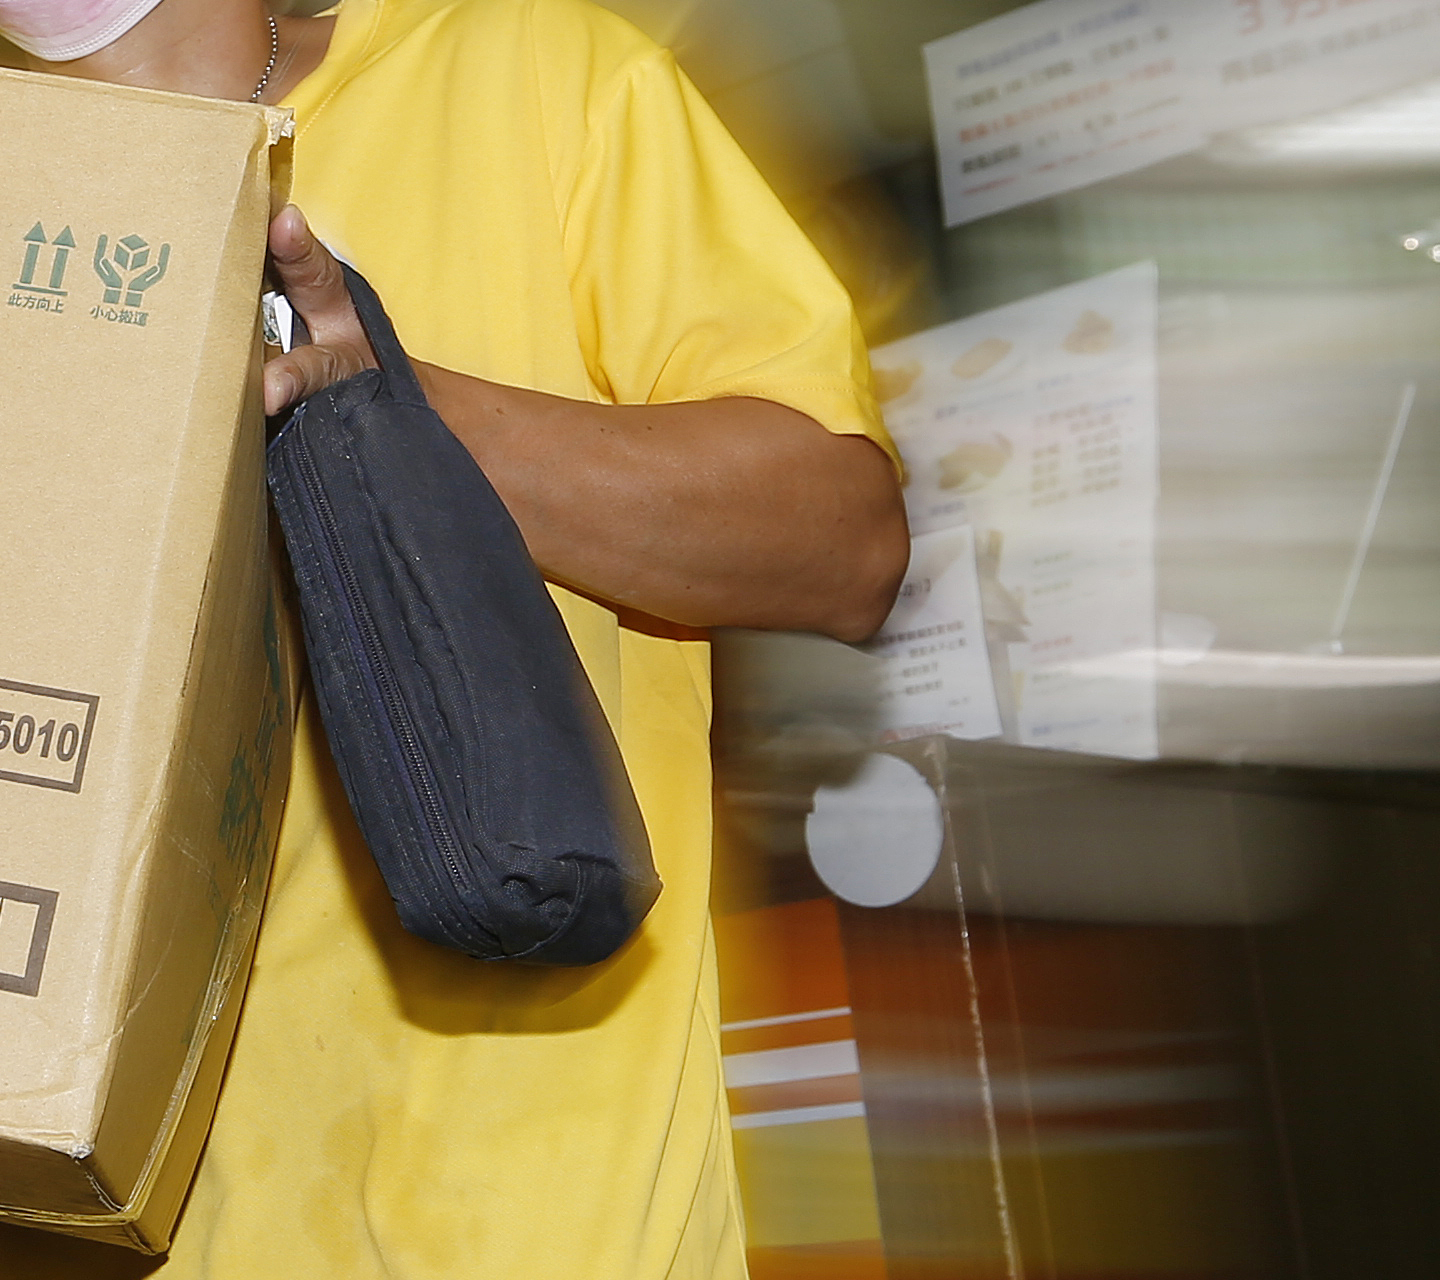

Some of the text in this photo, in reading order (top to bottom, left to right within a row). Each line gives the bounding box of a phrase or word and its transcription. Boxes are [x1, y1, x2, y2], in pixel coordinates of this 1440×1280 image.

[7, 293, 64, 315] 此方向上
[90, 304, 149, 327] 小心搬運
